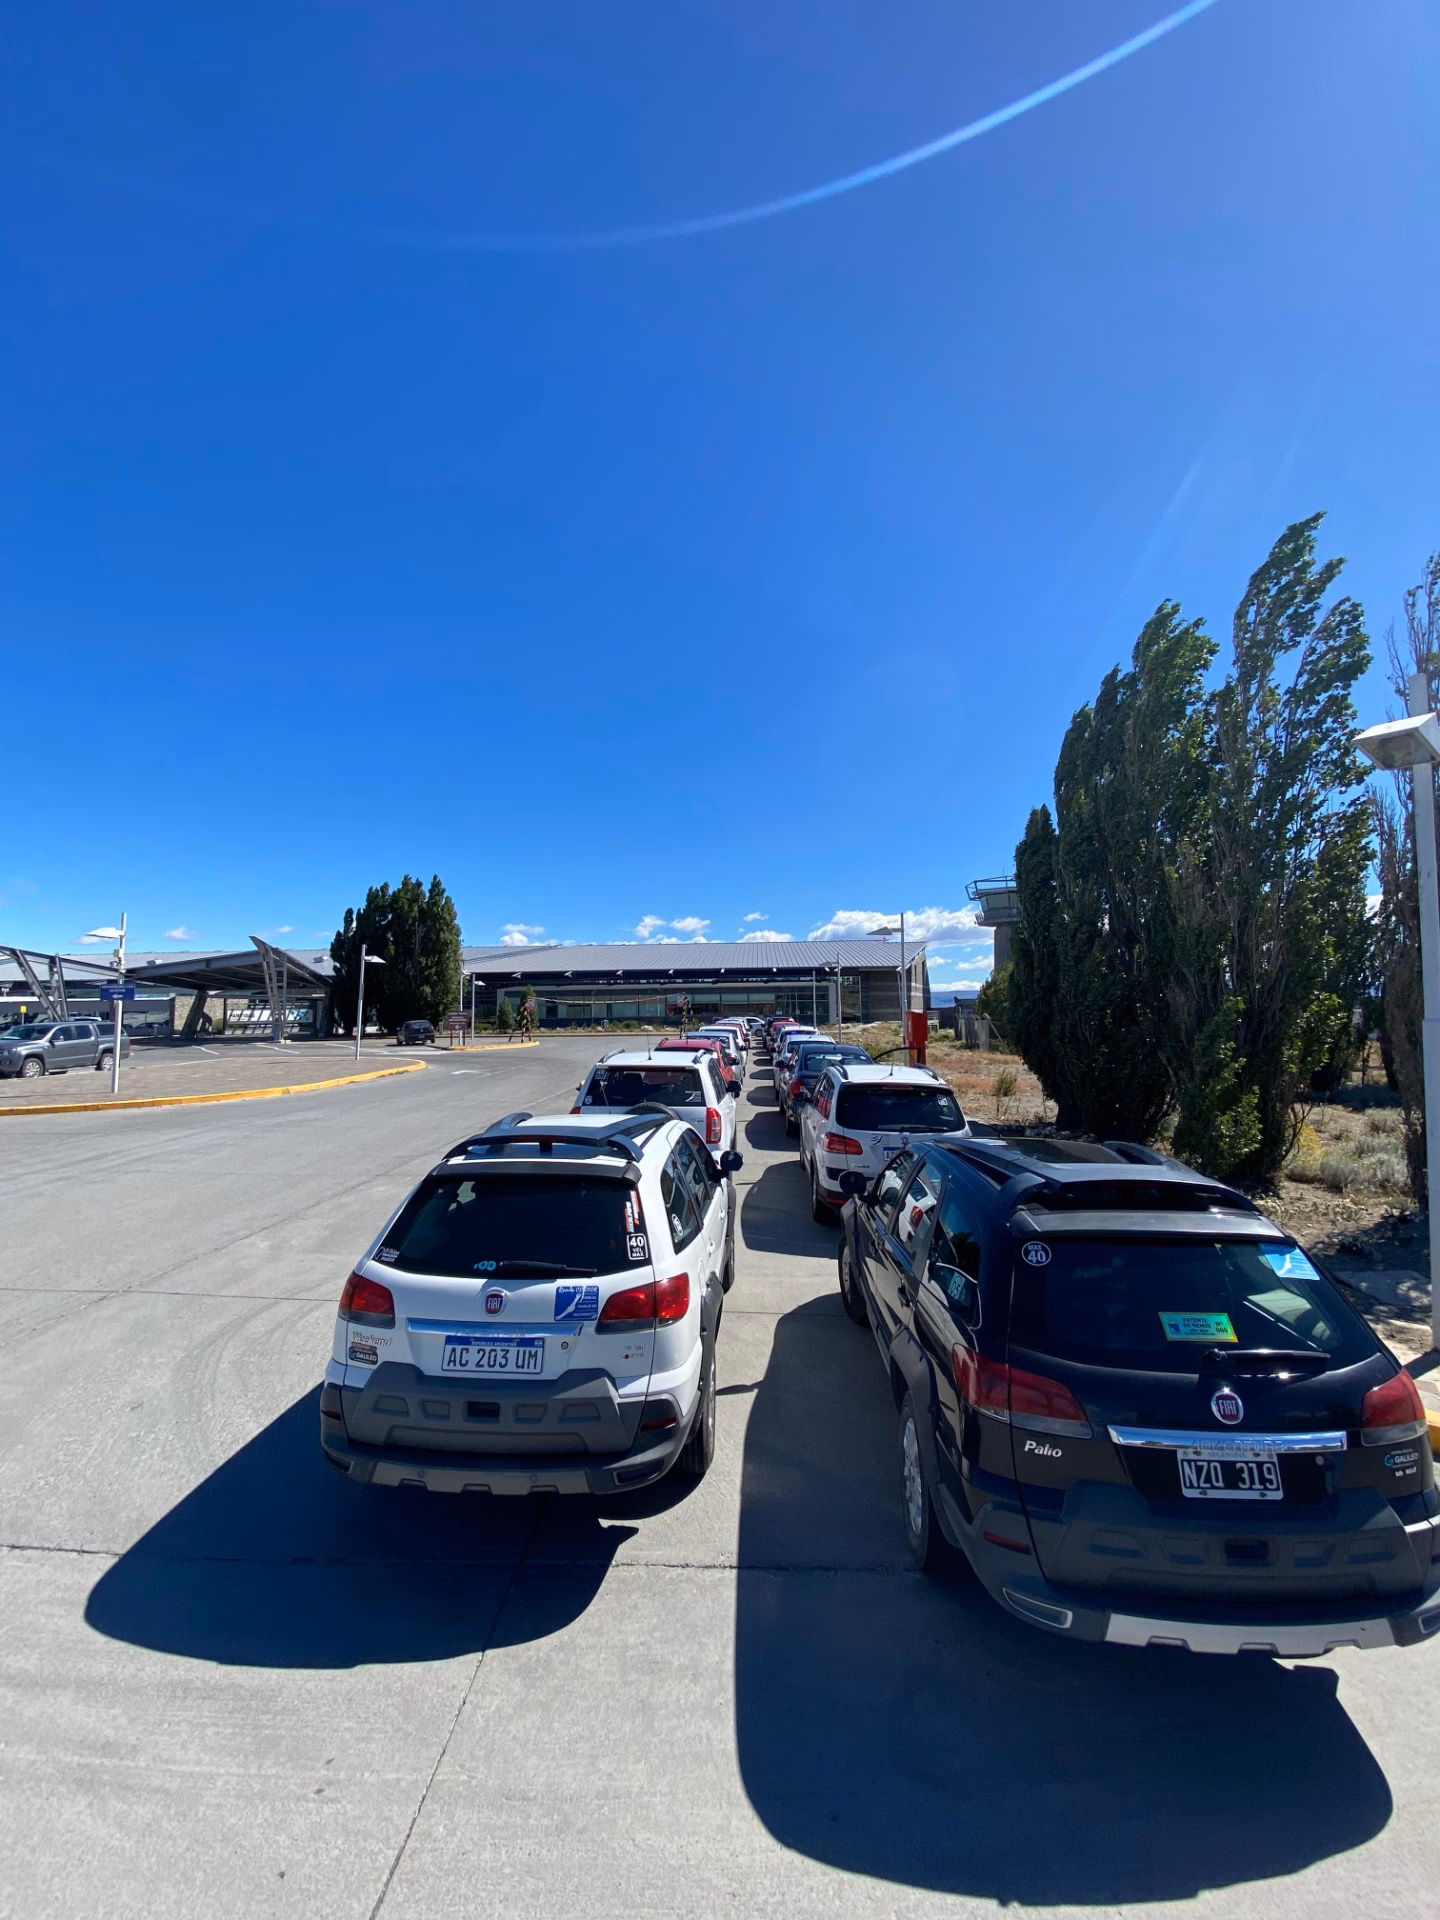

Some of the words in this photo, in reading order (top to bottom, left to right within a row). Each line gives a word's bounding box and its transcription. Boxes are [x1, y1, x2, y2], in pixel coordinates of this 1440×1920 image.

[629, 1236, 644, 1247] 40
[1027, 1250, 1047, 1263] 40
[487, 1297, 502, 1310] FIAT
[351, 1331, 392, 1347] Weekend
[355, 1352, 377, 1361] GALILEO
[447, 1347, 470, 1368] AC
[475, 1348, 510, 1369] 203
[515, 1349, 538, 1370] UM
[1218, 1399, 1237, 1416] FIAT
[1024, 1440, 1062, 1457] Palio
[1394, 1452, 1418, 1463] GALILEO
[1182, 1461, 1225, 1488] NZQ
[1235, 1462, 1278, 1489] 319
